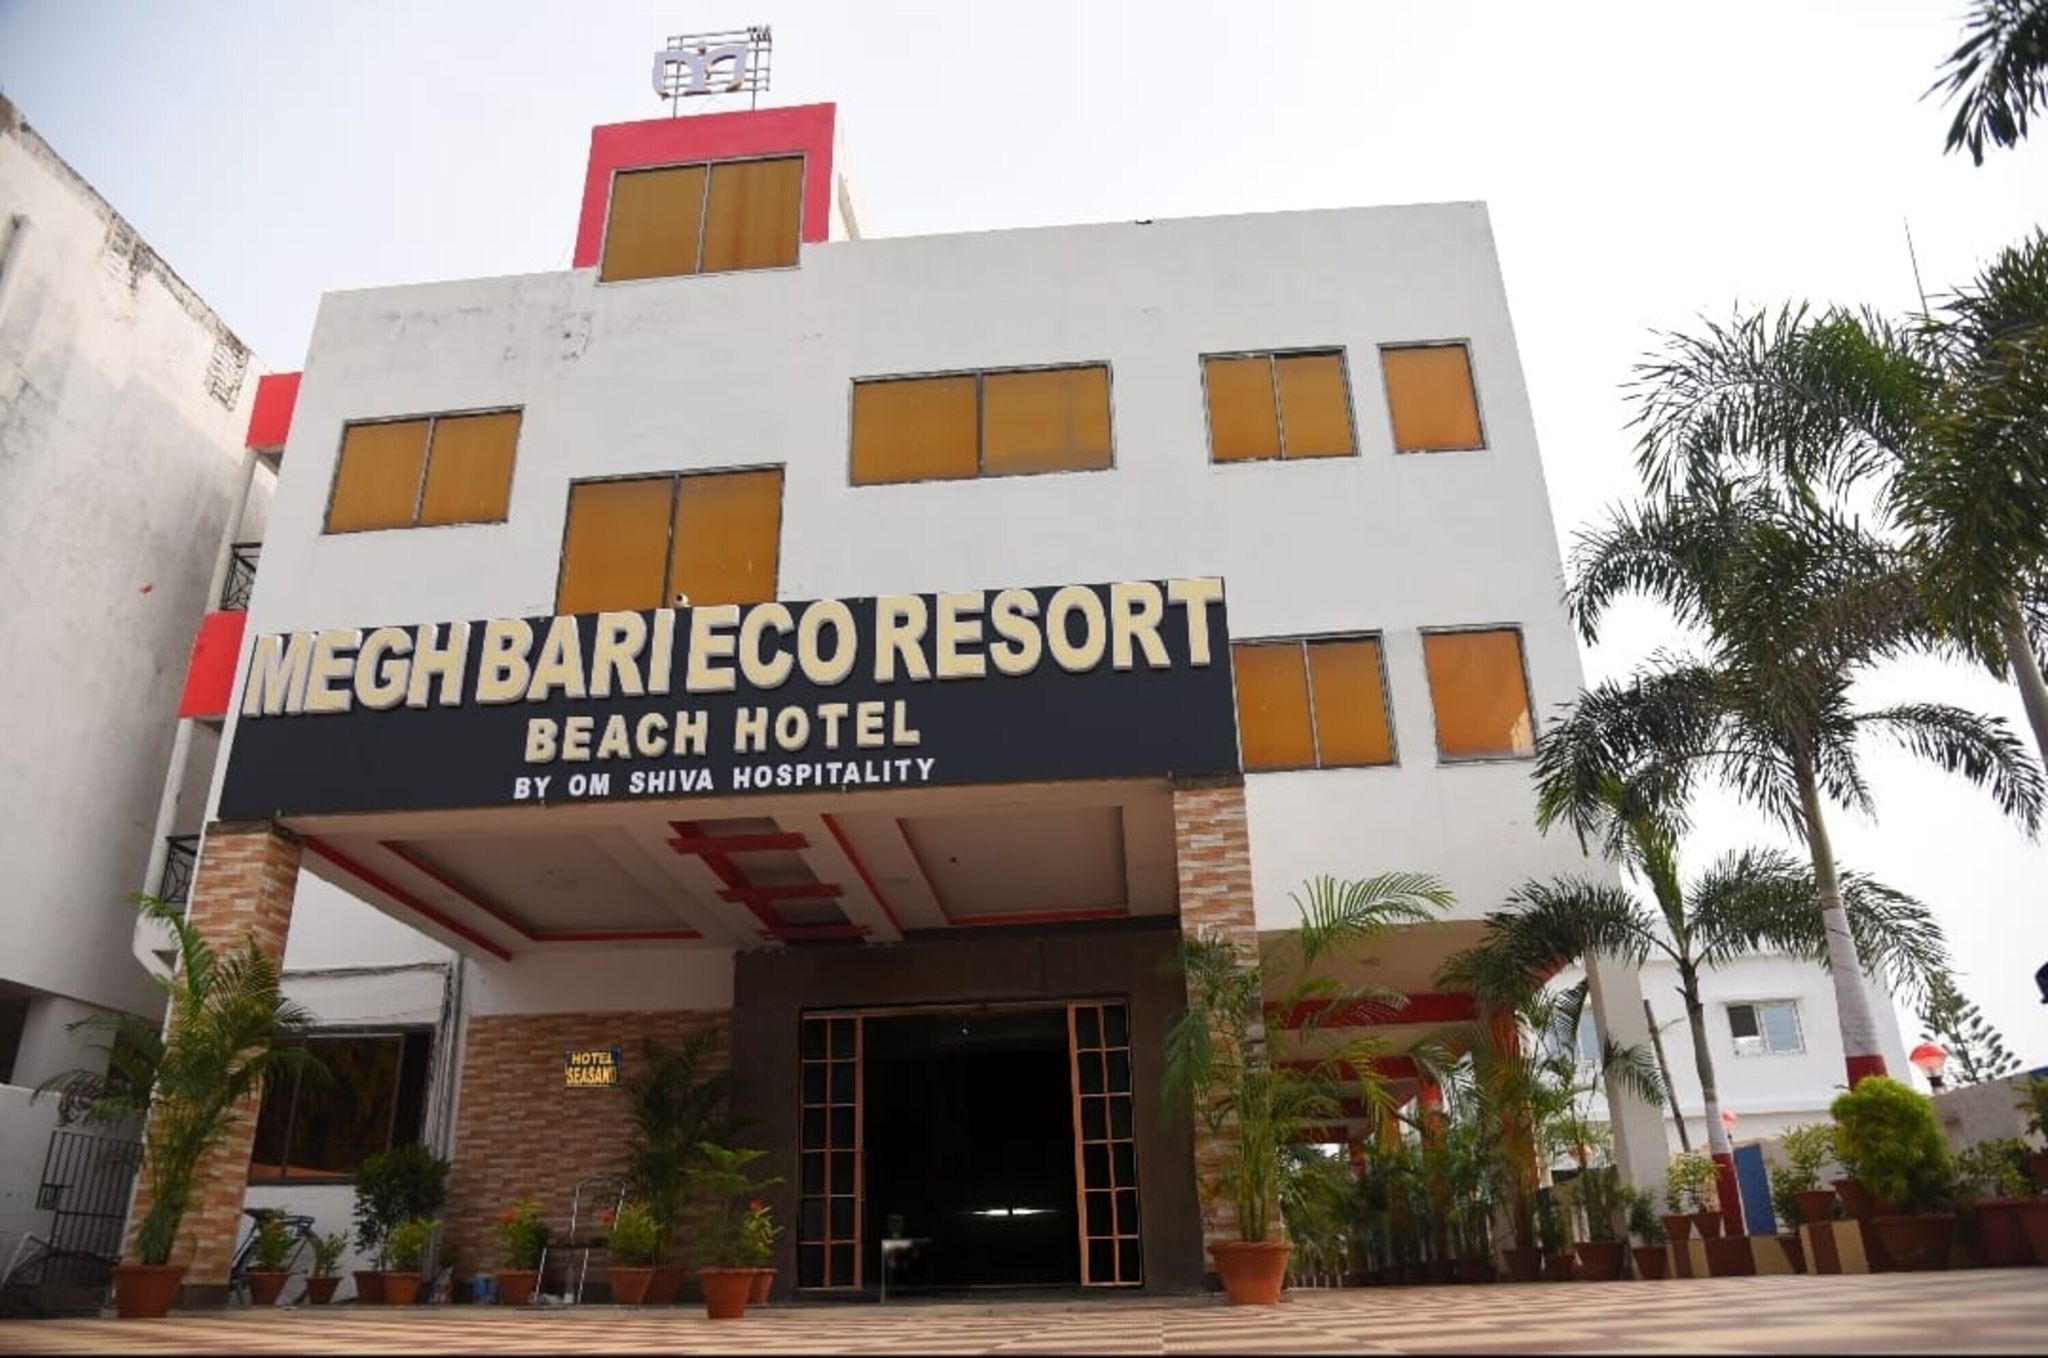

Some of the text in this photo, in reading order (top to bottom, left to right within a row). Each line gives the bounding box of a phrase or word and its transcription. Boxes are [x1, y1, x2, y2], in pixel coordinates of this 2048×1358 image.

[242, 577, 1223, 717] MEGH BARI ECO RESORT
[524, 699, 921, 764] BEACH HOTEL
[513, 757, 935, 800] BY OM SHIVA HOSPITALITY
[571, 1050, 616, 1065] HOTEL
